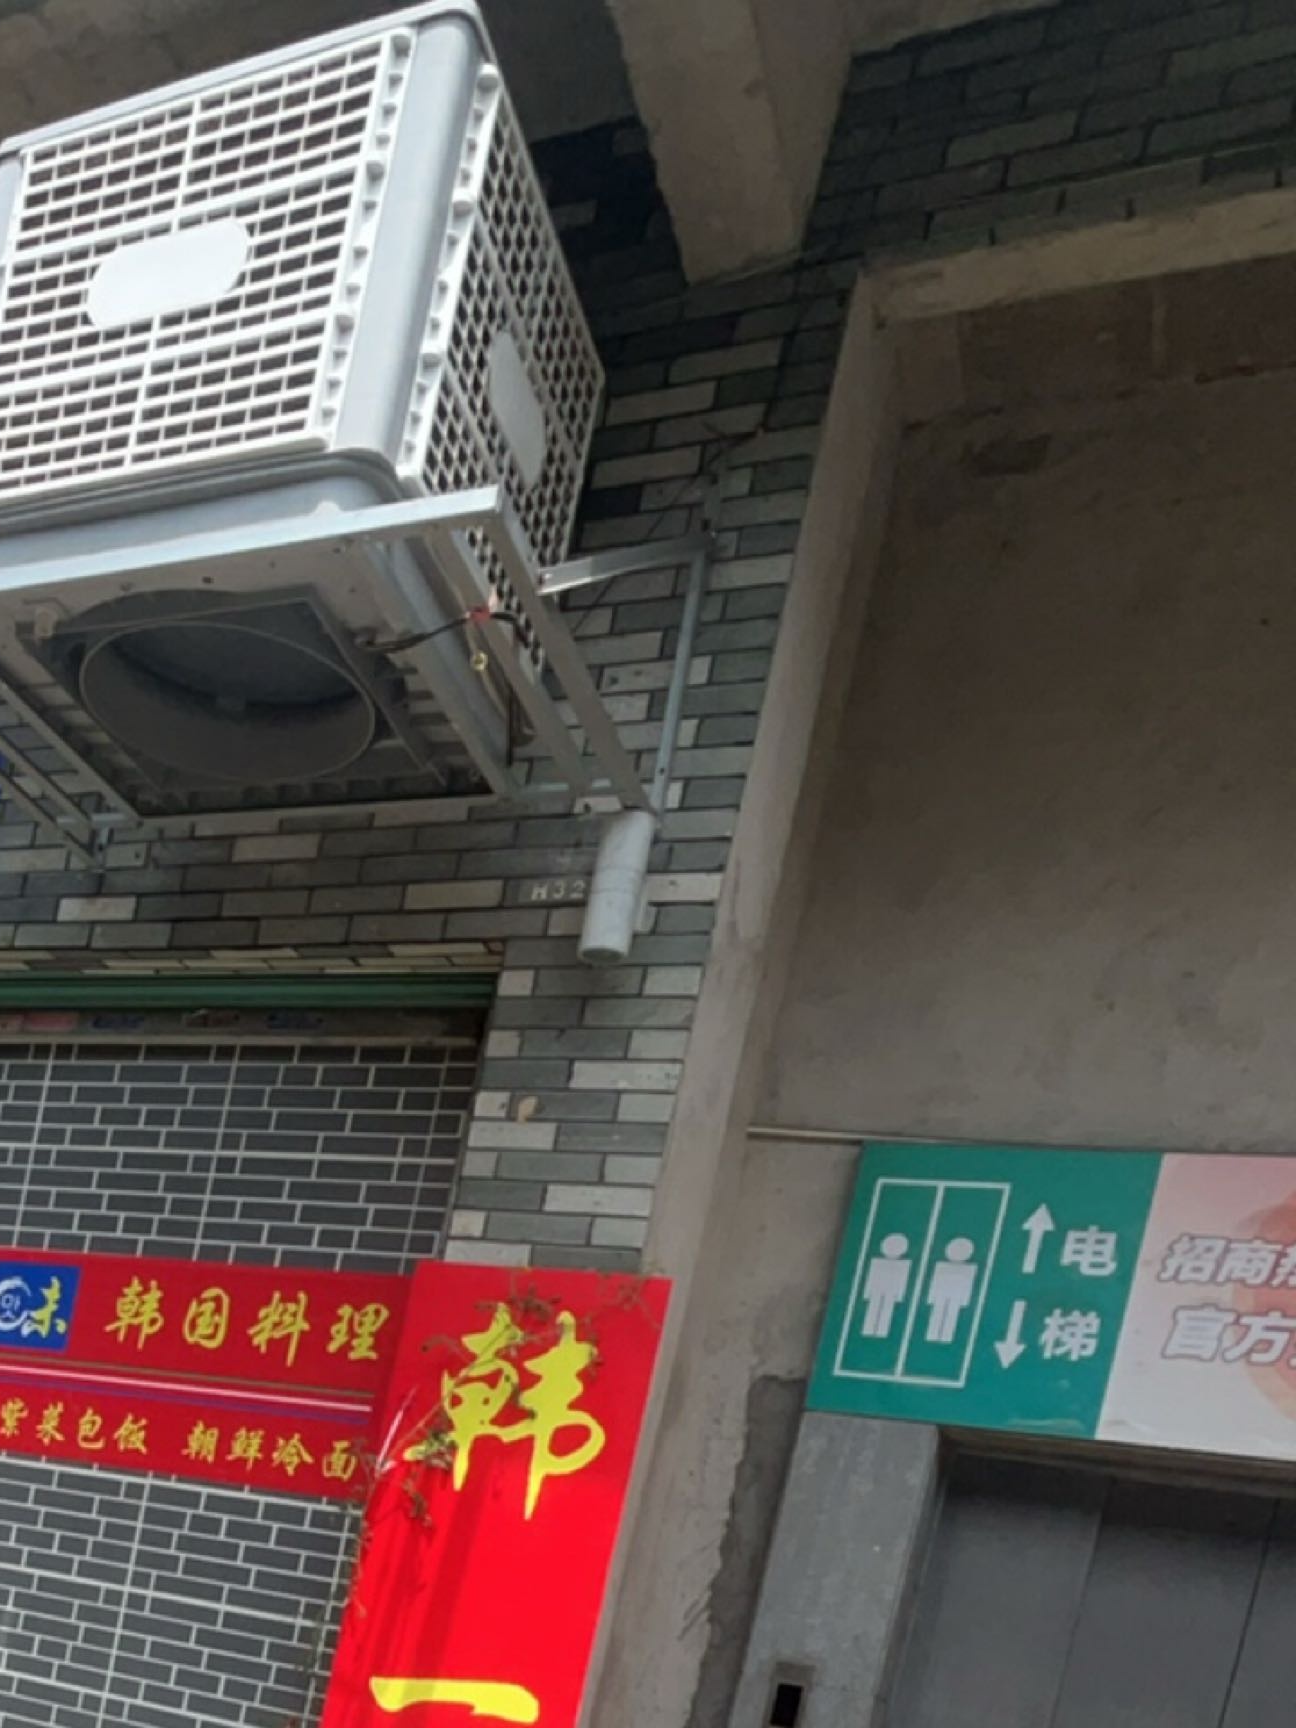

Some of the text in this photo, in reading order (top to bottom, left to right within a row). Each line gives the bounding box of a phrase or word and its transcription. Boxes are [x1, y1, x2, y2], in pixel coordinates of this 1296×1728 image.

[103, 1275, 390, 1368] 韩国料理
[1160, 1303, 1296, 1369] 官方
[0, 1396, 149, 1455] 紫菜包饭
[180, 1420, 359, 1483] 朝鲜冷面
